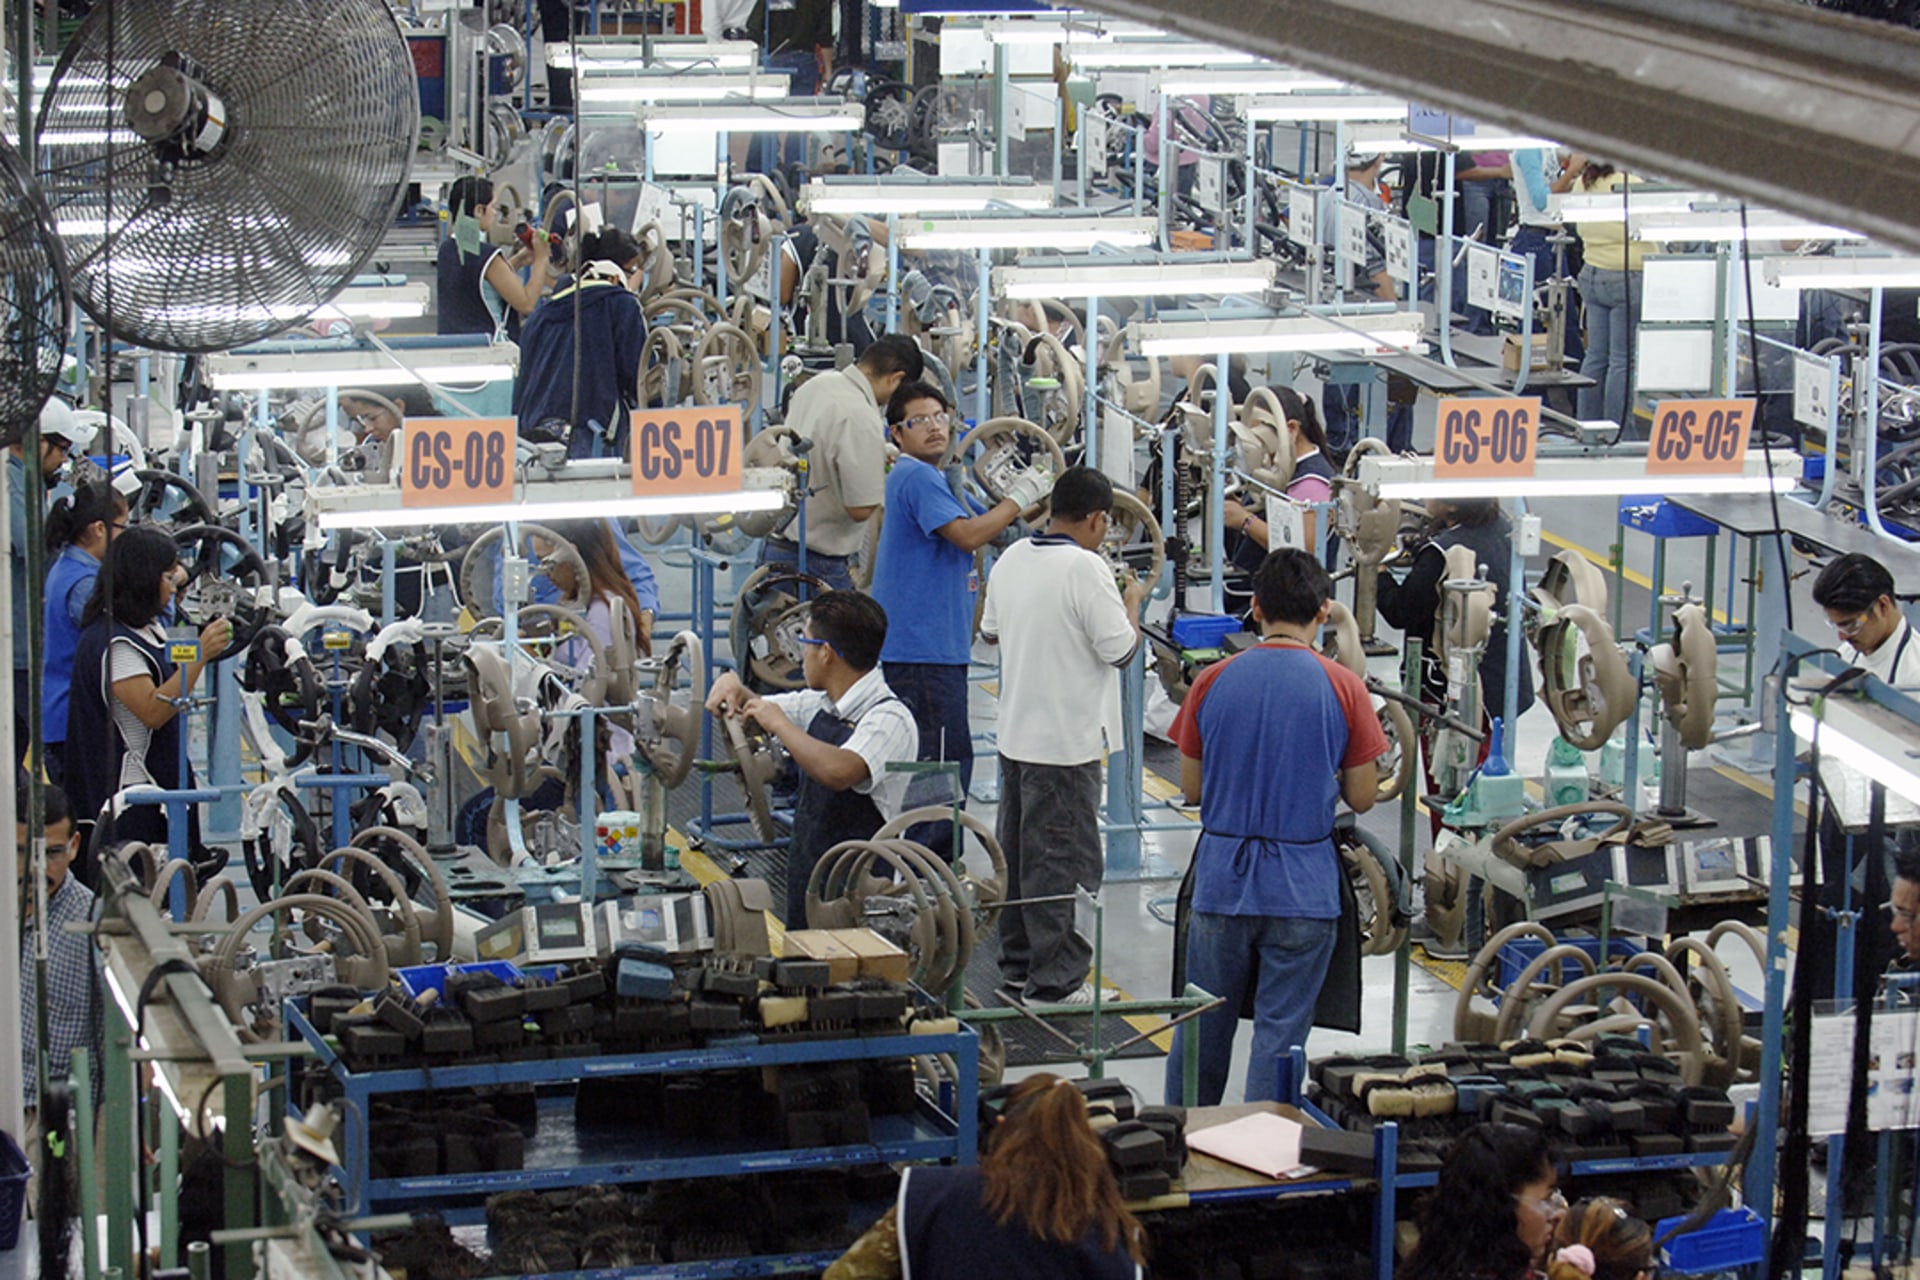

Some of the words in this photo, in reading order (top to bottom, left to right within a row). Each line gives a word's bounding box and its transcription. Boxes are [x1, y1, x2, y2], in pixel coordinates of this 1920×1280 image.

[411, 430, 505, 489] CS-08
[640, 419, 731, 480] CS-07
[1443, 408, 1529, 465] CS-06
[1656, 409, 1742, 461] CS-05
